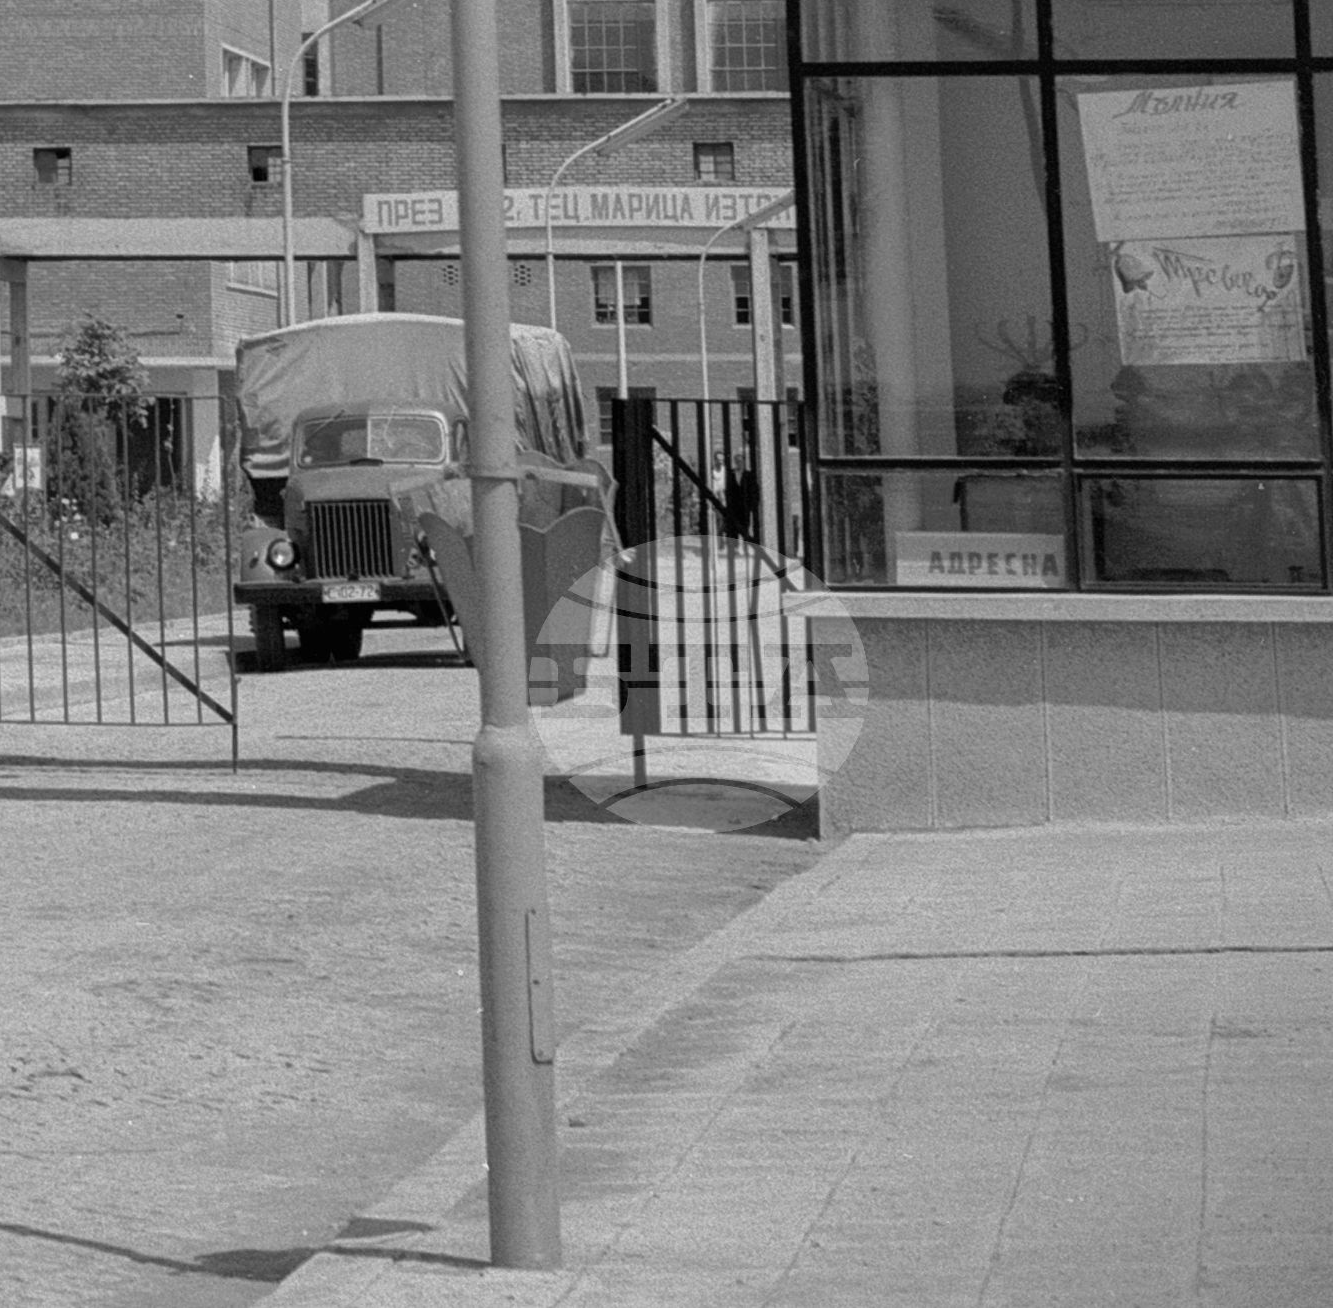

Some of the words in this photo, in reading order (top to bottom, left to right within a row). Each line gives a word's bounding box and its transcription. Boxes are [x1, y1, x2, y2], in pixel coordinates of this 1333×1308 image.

[377, 198, 443, 227] ПРЕЗ
[529, 193, 580, 223] ТЕЦ
[705, 193, 791, 222] ИЗТ
[928, 550, 1060, 577] АДРЕСНА
